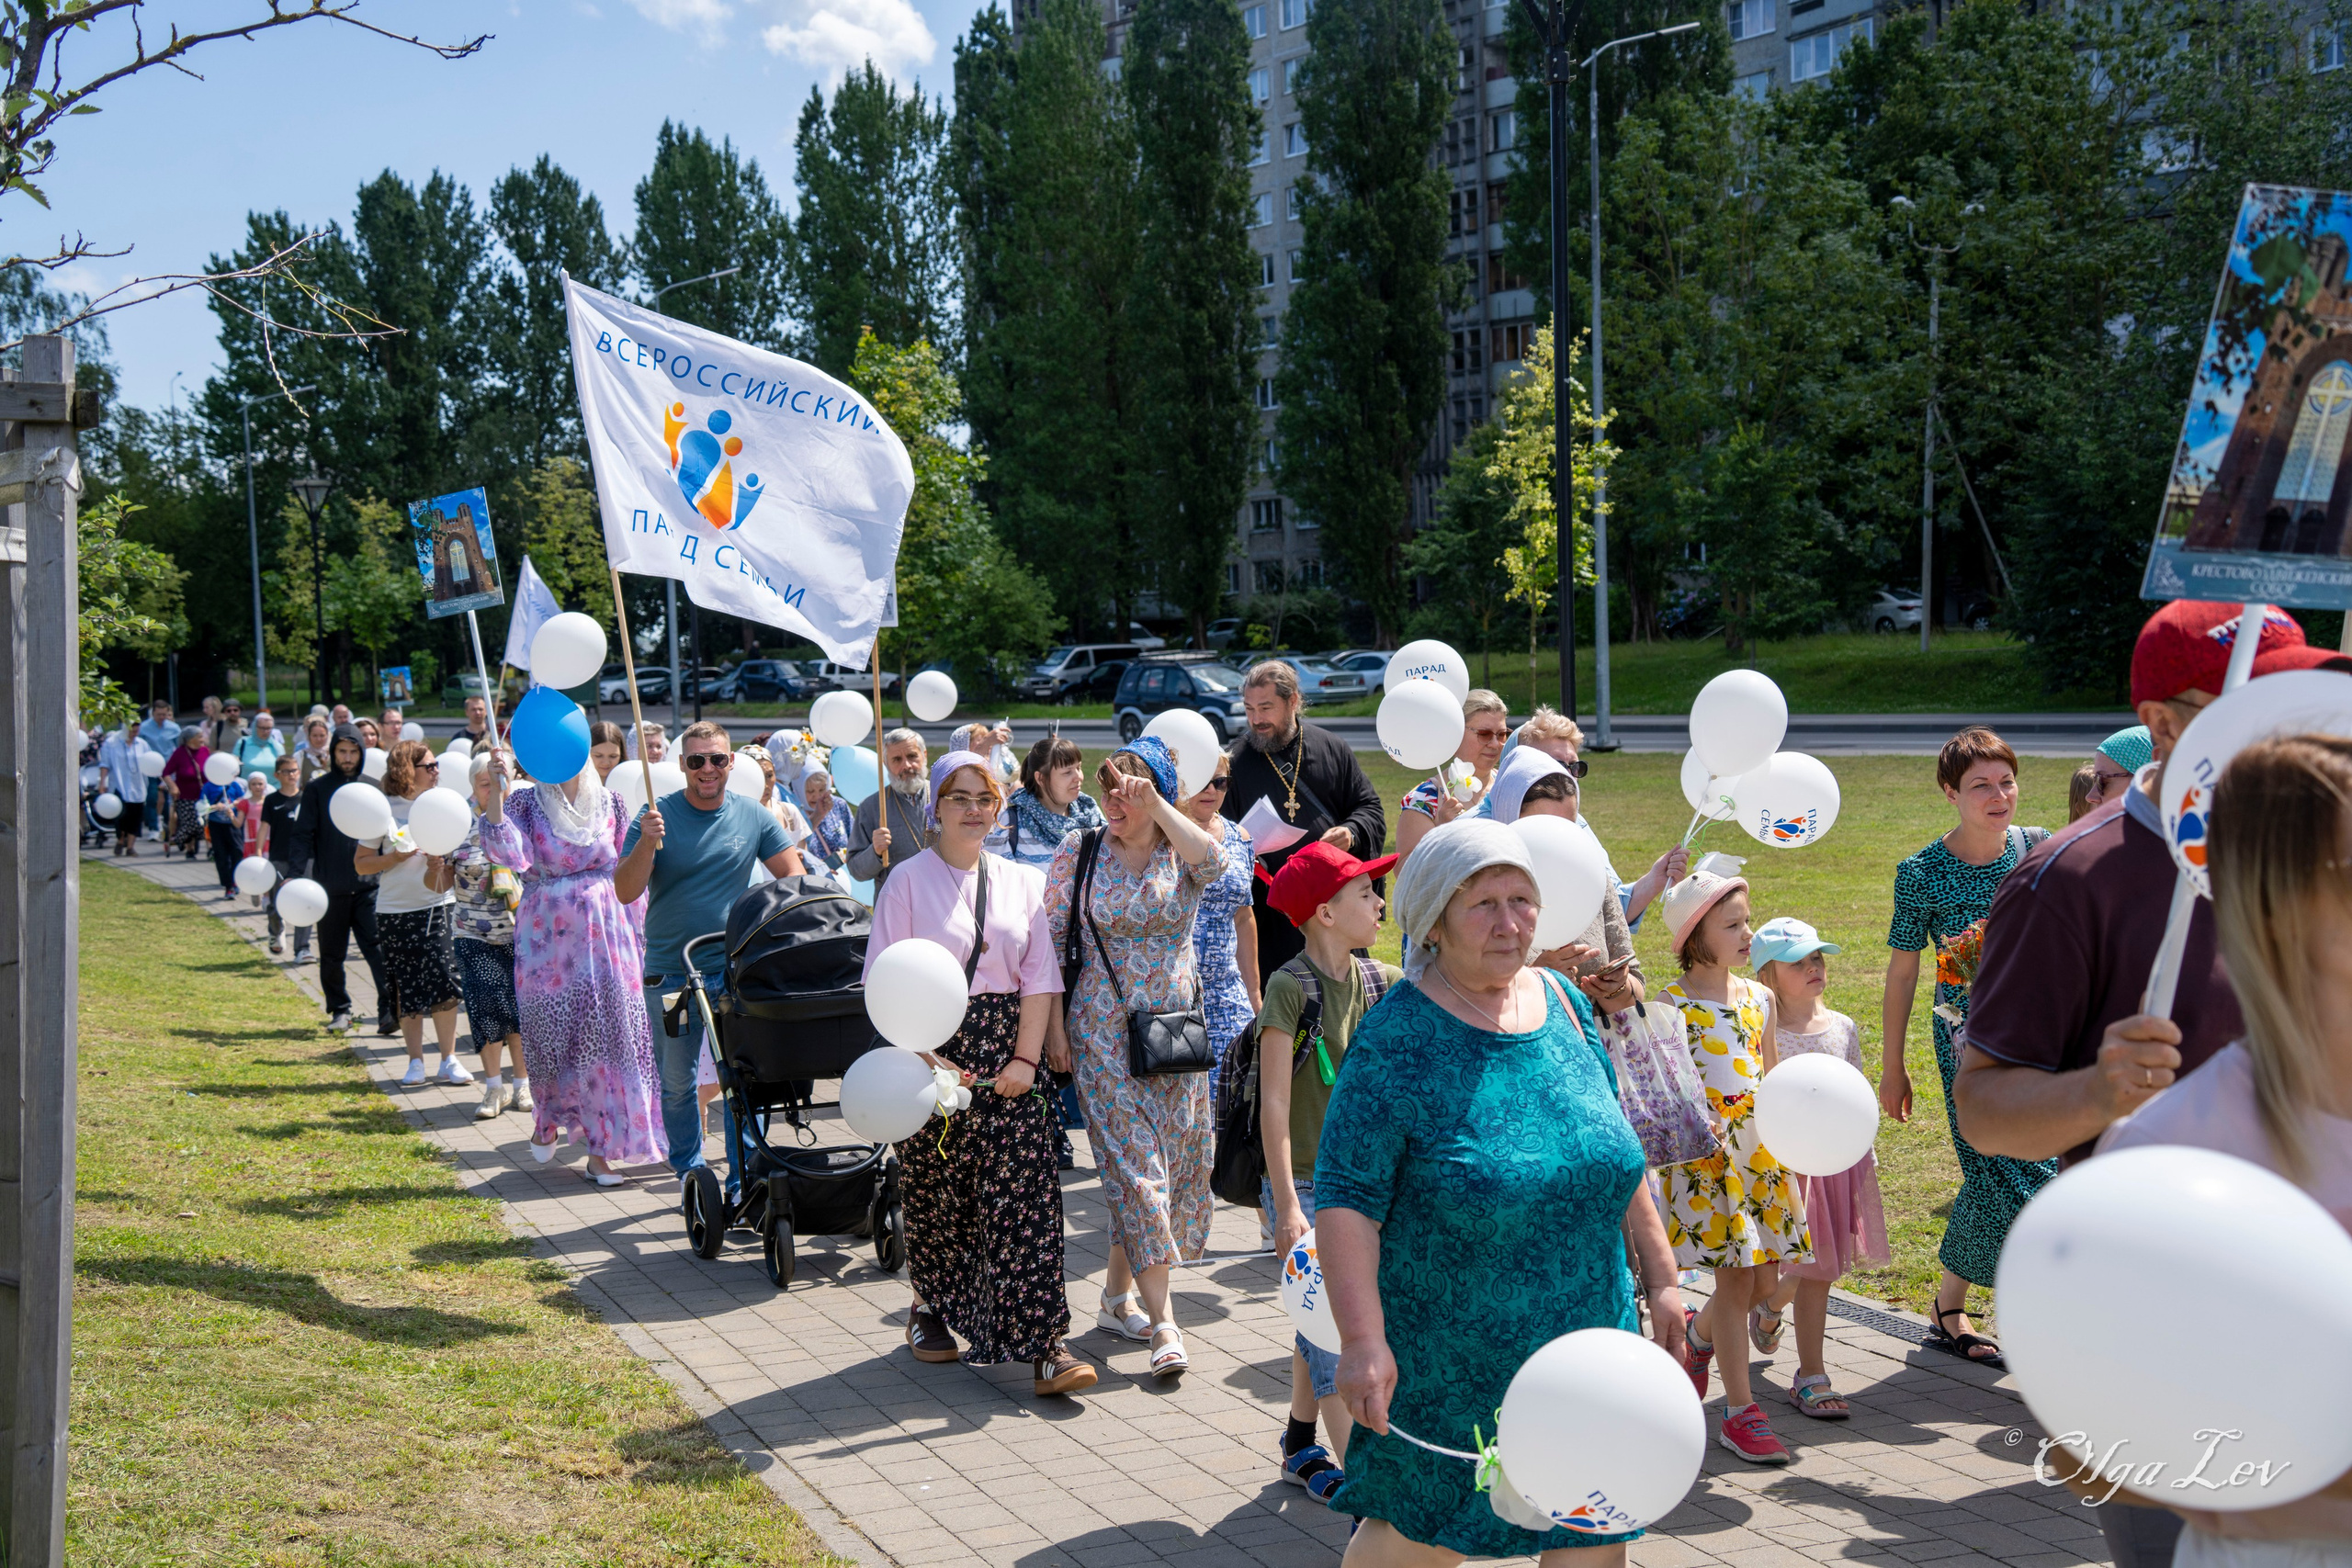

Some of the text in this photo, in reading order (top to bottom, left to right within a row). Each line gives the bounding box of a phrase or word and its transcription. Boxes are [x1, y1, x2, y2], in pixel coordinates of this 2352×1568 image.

[632, 509, 699, 566] ПАД
[1406, 664, 1446, 677] ПАРАД
[1301, 1267, 1324, 1312] РАД
